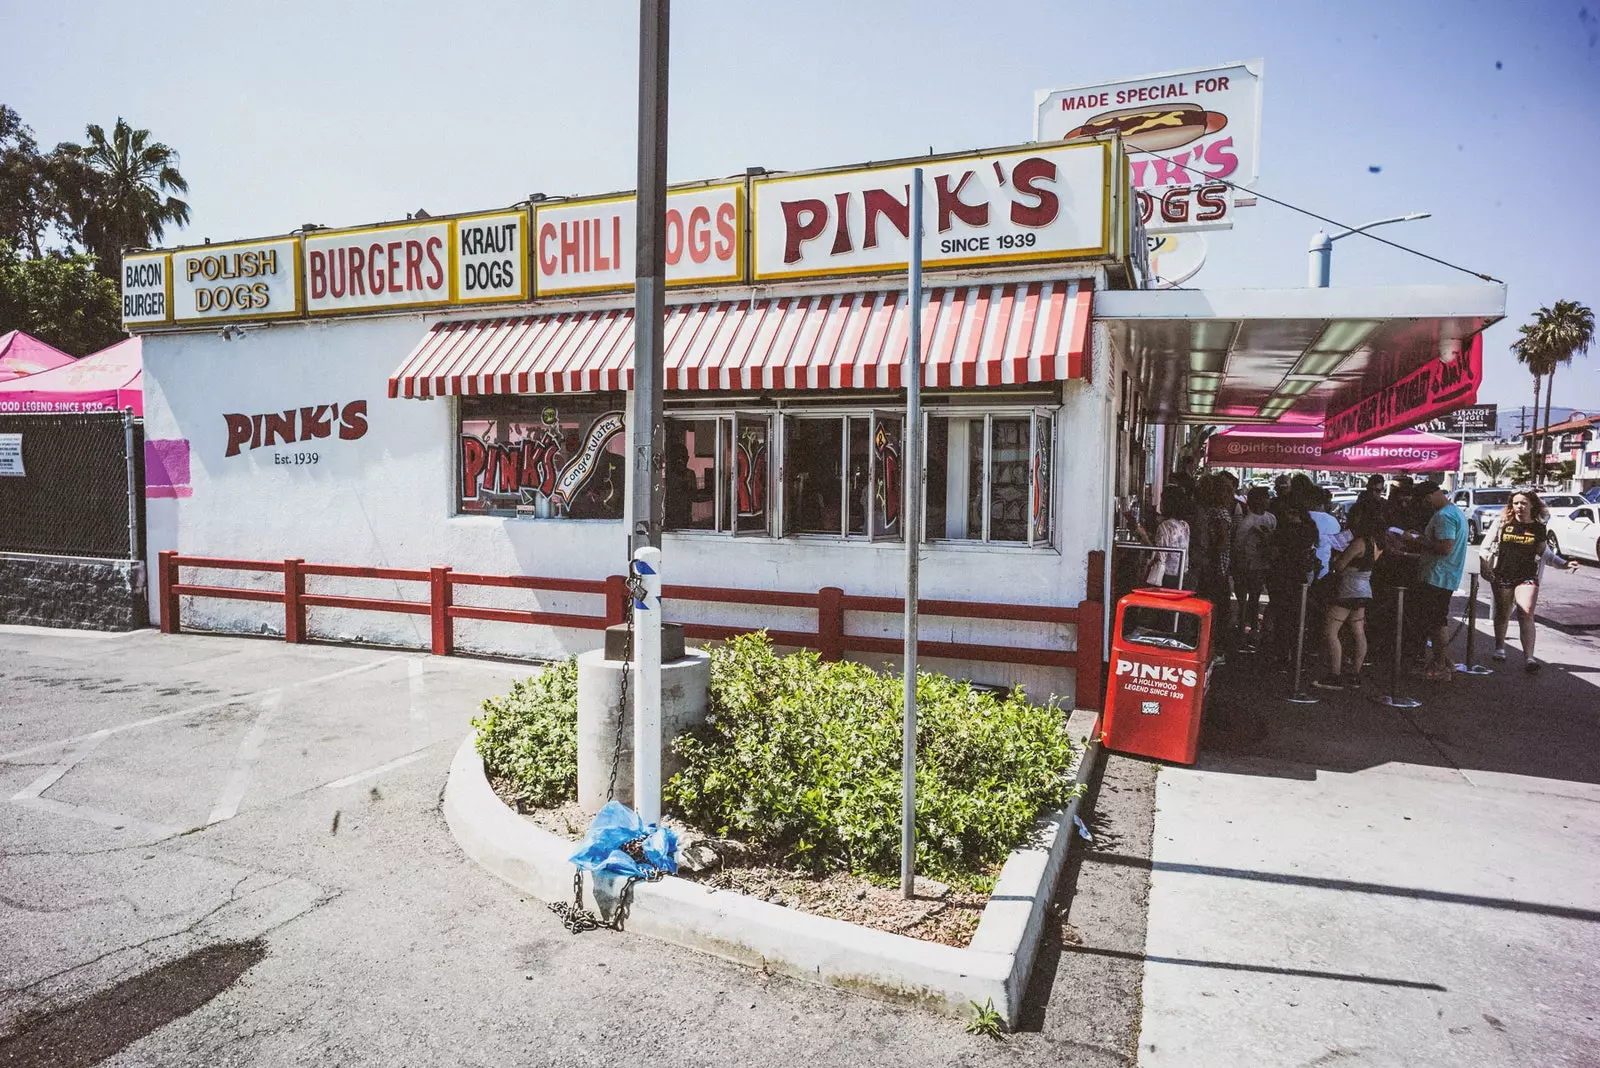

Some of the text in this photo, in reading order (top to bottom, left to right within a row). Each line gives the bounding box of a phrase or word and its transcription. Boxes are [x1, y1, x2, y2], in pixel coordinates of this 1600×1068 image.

[1061, 76, 1230, 111] MADE SPECIAL FOR
[780, 157, 1061, 265] PINK'S
[1135, 184, 1228, 225] OGS
[461, 223, 517, 256] KRAUT
[539, 202, 735, 276] CHILI OGS
[940, 232, 1036, 254] SINCE 1939
[125, 263, 162, 288] BACON
[186, 249, 277, 282] POLISH
[309, 236, 444, 300] BURGERS
[465, 260, 514, 290] DOGS
[124, 292, 165, 317] BURGER
[195, 283, 270, 312] DOGS
[0, 401, 20, 412] OOD
[22, 401, 53, 412] LEGEND
[55, 402, 79, 412] SINCE
[222, 400, 369, 457] PINK'S
[274, 452, 319, 465] Est. 1939
[1227, 442, 1321, 457] @pinkshotdog
[1116, 659, 1198, 688] PINK'S
[1139, 679, 1178, 691] HOLLYWOOD
[1124, 683, 1149, 693] LEGEND
[1149, 688, 1169, 697] SINCE
